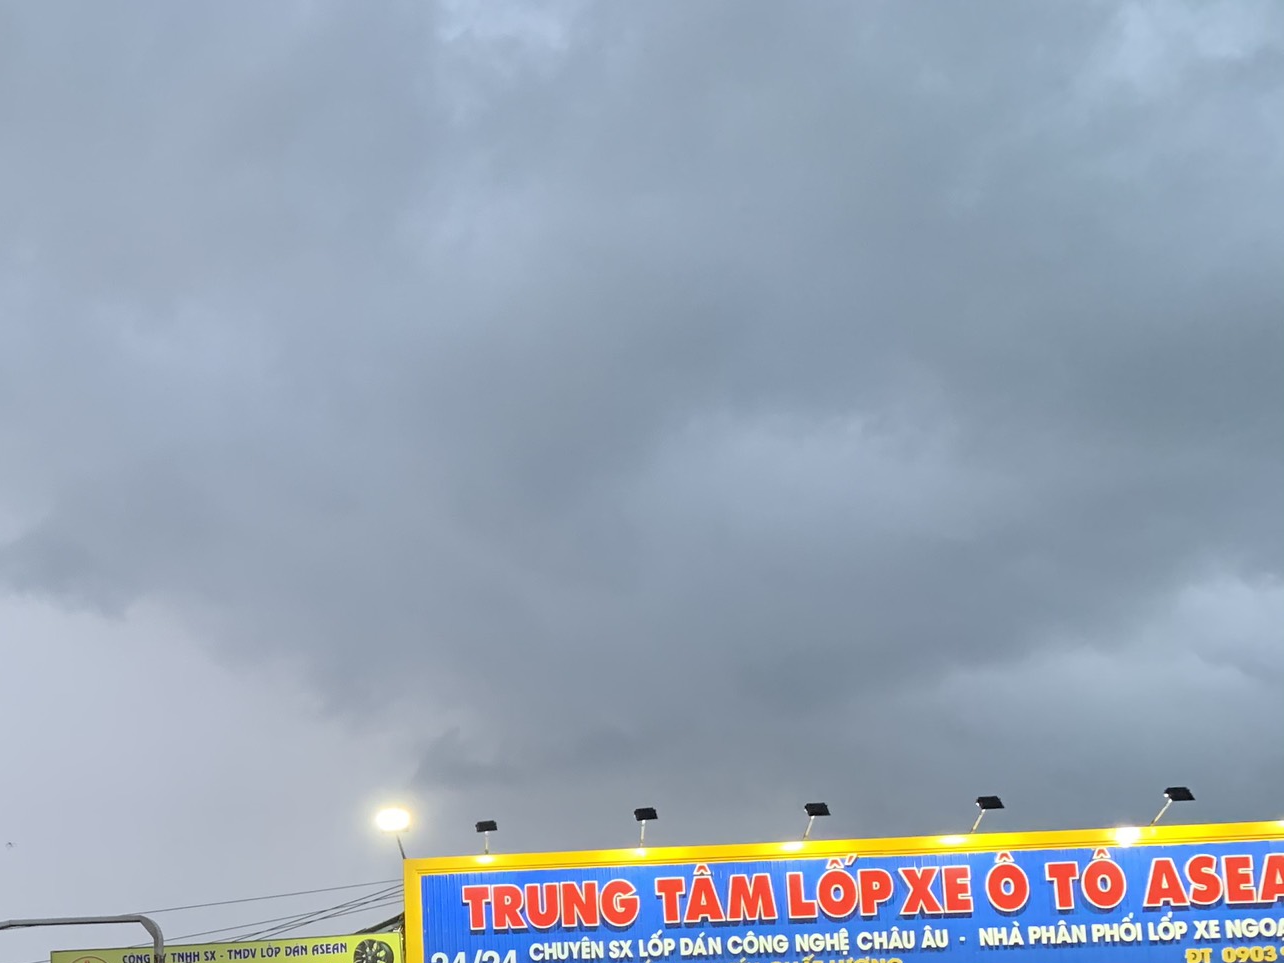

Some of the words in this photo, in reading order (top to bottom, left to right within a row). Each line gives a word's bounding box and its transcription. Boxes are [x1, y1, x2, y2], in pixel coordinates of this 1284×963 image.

[462, 879, 640, 930] TRUNG
[655, 863, 778, 923] TÂM
[786, 854, 894, 918] LỐP
[898, 864, 974, 916] XE
[985, 849, 1030, 912] Ô
[1045, 847, 1126, 910] TÔ
[171, 951, 200, 963] TNHH
[204, 950, 217, 962] SX
[227, 948, 256, 960] TMDV
[312, 943, 347, 955] ASEAN
[529, 936, 604, 961] CHUYÊN
[609, 940, 632, 958] SX
[638, 930, 676, 957] LỐP
[680, 932, 722, 955] DÁN
[727, 931, 789, 955] CÔNG
[795, 928, 850, 955] NGHỆ
[857, 926, 916, 950] CHÂU
[921, 925, 949, 949] ÂU
[979, 921, 1024, 947] NHÀ
[1028, 920, 1087, 945] PHÂN
[1193, 920, 1220, 940] XE
[1222, 945, 1278, 963] 0903
